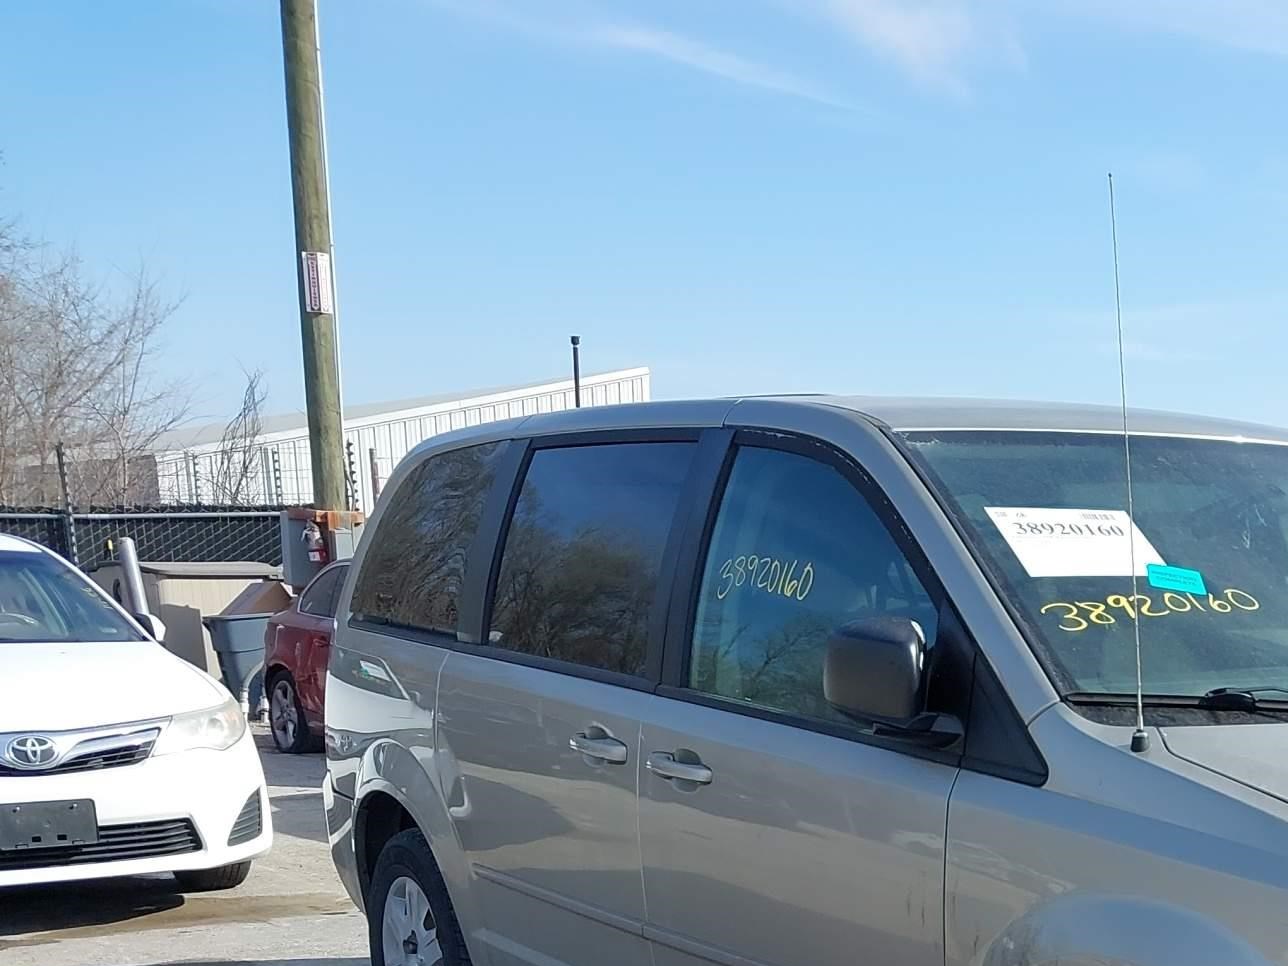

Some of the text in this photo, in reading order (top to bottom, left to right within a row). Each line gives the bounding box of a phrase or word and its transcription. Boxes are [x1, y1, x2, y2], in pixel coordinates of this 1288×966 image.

[1011, 521, 1125, 537] 38920160
[717, 555, 815, 600] 38920160
[1040, 588, 1260, 632] 38920160
